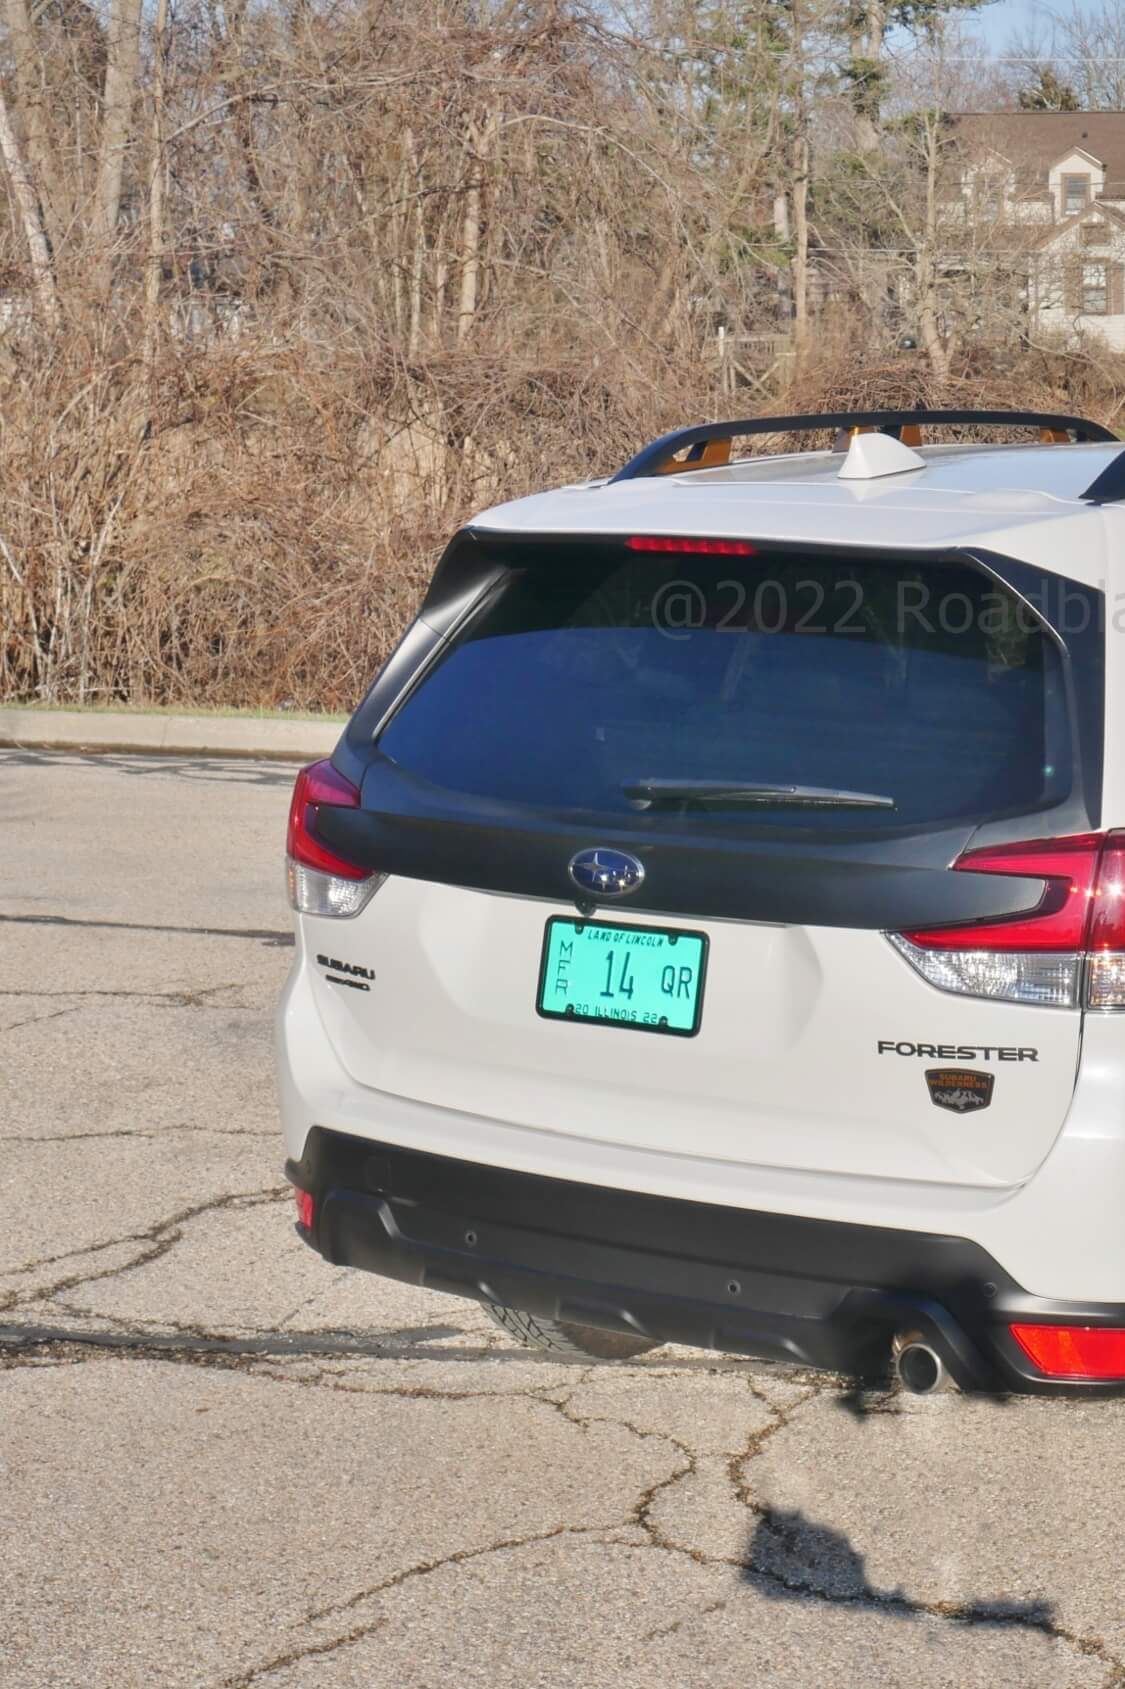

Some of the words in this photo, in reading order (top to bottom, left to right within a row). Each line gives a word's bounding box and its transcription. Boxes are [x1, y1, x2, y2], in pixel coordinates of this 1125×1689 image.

[587, 930, 611, 943] LAND
[613, 932, 623, 943] OF
[626, 933, 665, 948] LINCOLN
[316, 953, 375, 980] SUBARU
[600, 950, 634, 1000] 14
[661, 965, 693, 999] QR
[575, 1003, 589, 1015] 20
[595, 1006, 638, 1021] ILLINOIS
[643, 1012, 657, 1024] 22
[877, 1040, 1039, 1062] FORESTER
